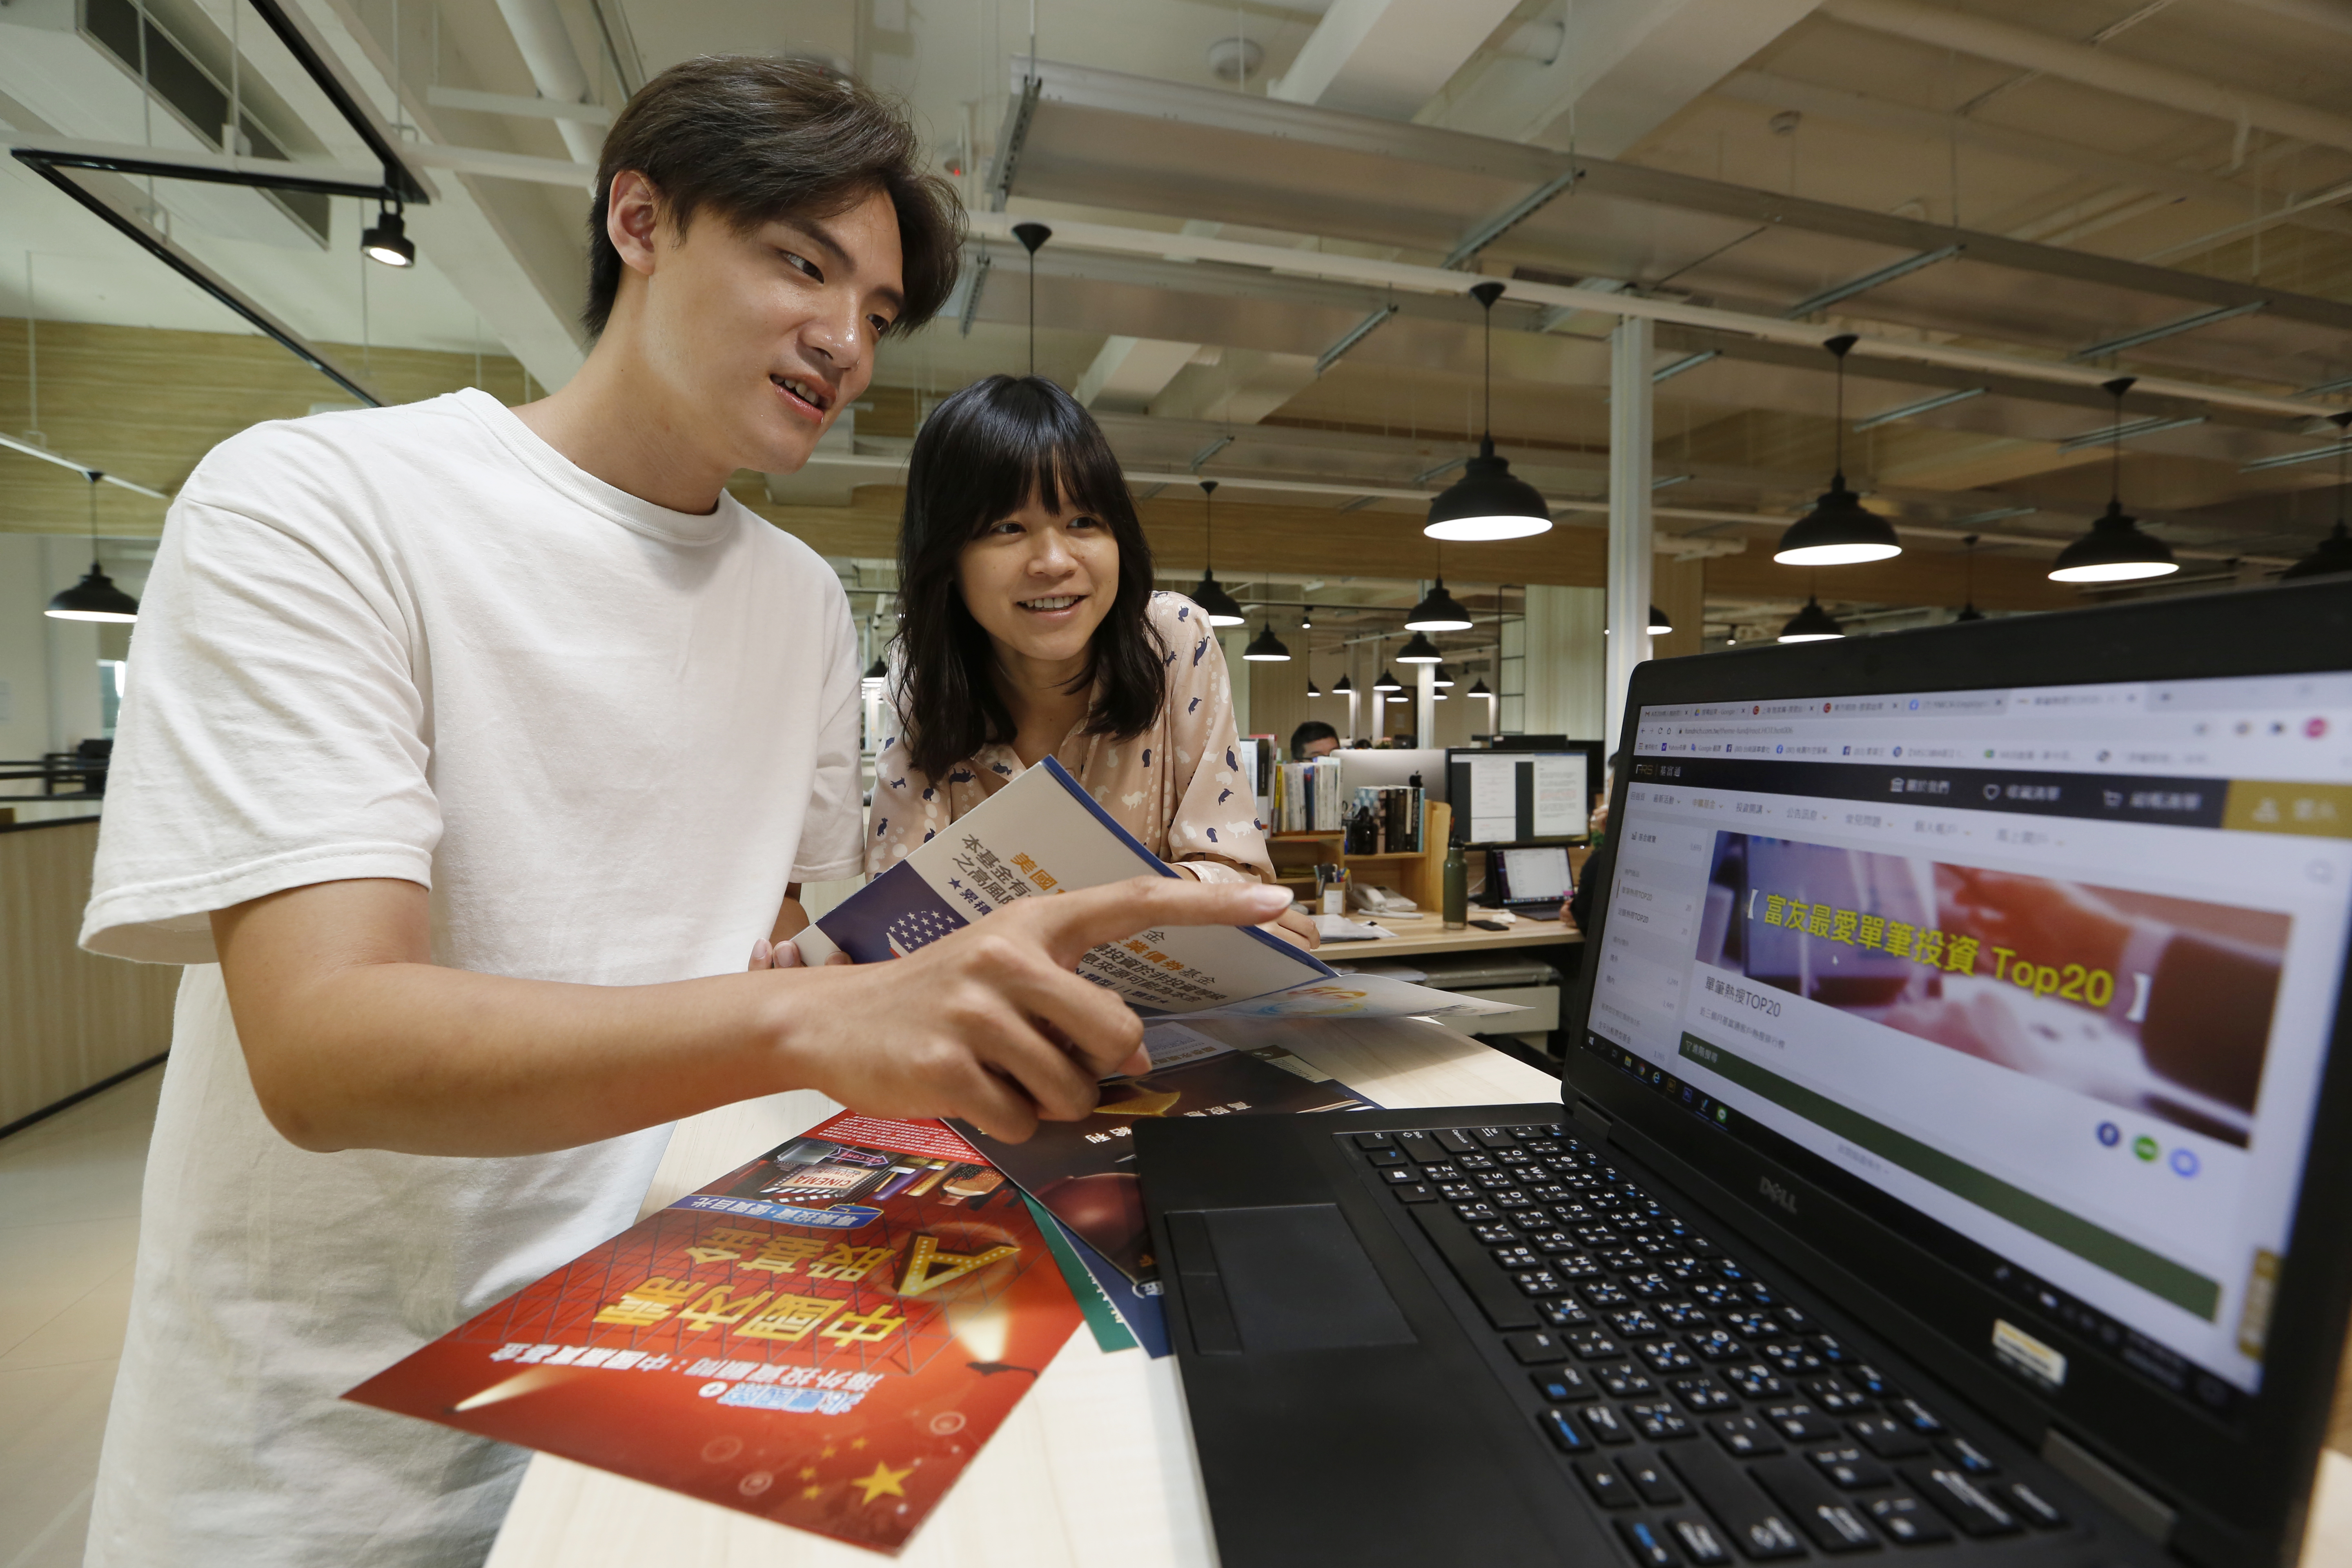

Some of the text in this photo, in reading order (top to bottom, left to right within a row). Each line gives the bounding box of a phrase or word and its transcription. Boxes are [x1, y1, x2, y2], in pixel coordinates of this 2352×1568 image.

[1660, 765, 1681, 777] 基富通
[962, 834, 1032, 897] 本基金有
[1010, 852, 1066, 895] 美國
[959, 888, 993, 916] 累積
[1142, 930, 1165, 944] 金
[1764, 893, 1980, 977] 富友最愛單筆投資
[1990, 946, 2115, 1008] Top20
[1113, 938, 1216, 986] 業債券基金
[1081, 953, 1202, 1003] 息來源可能為本金
[793, 1175, 851, 1187] CINEMA
[1759, 1176, 1797, 1215] DELL
[1575, 1256, 1590, 1265] H
[1537, 1272, 1552, 1281] N
[1601, 1283, 1616, 1291] J
[1647, 1274, 1663, 1283] U
[591, 1275, 906, 1348] 中國內需
